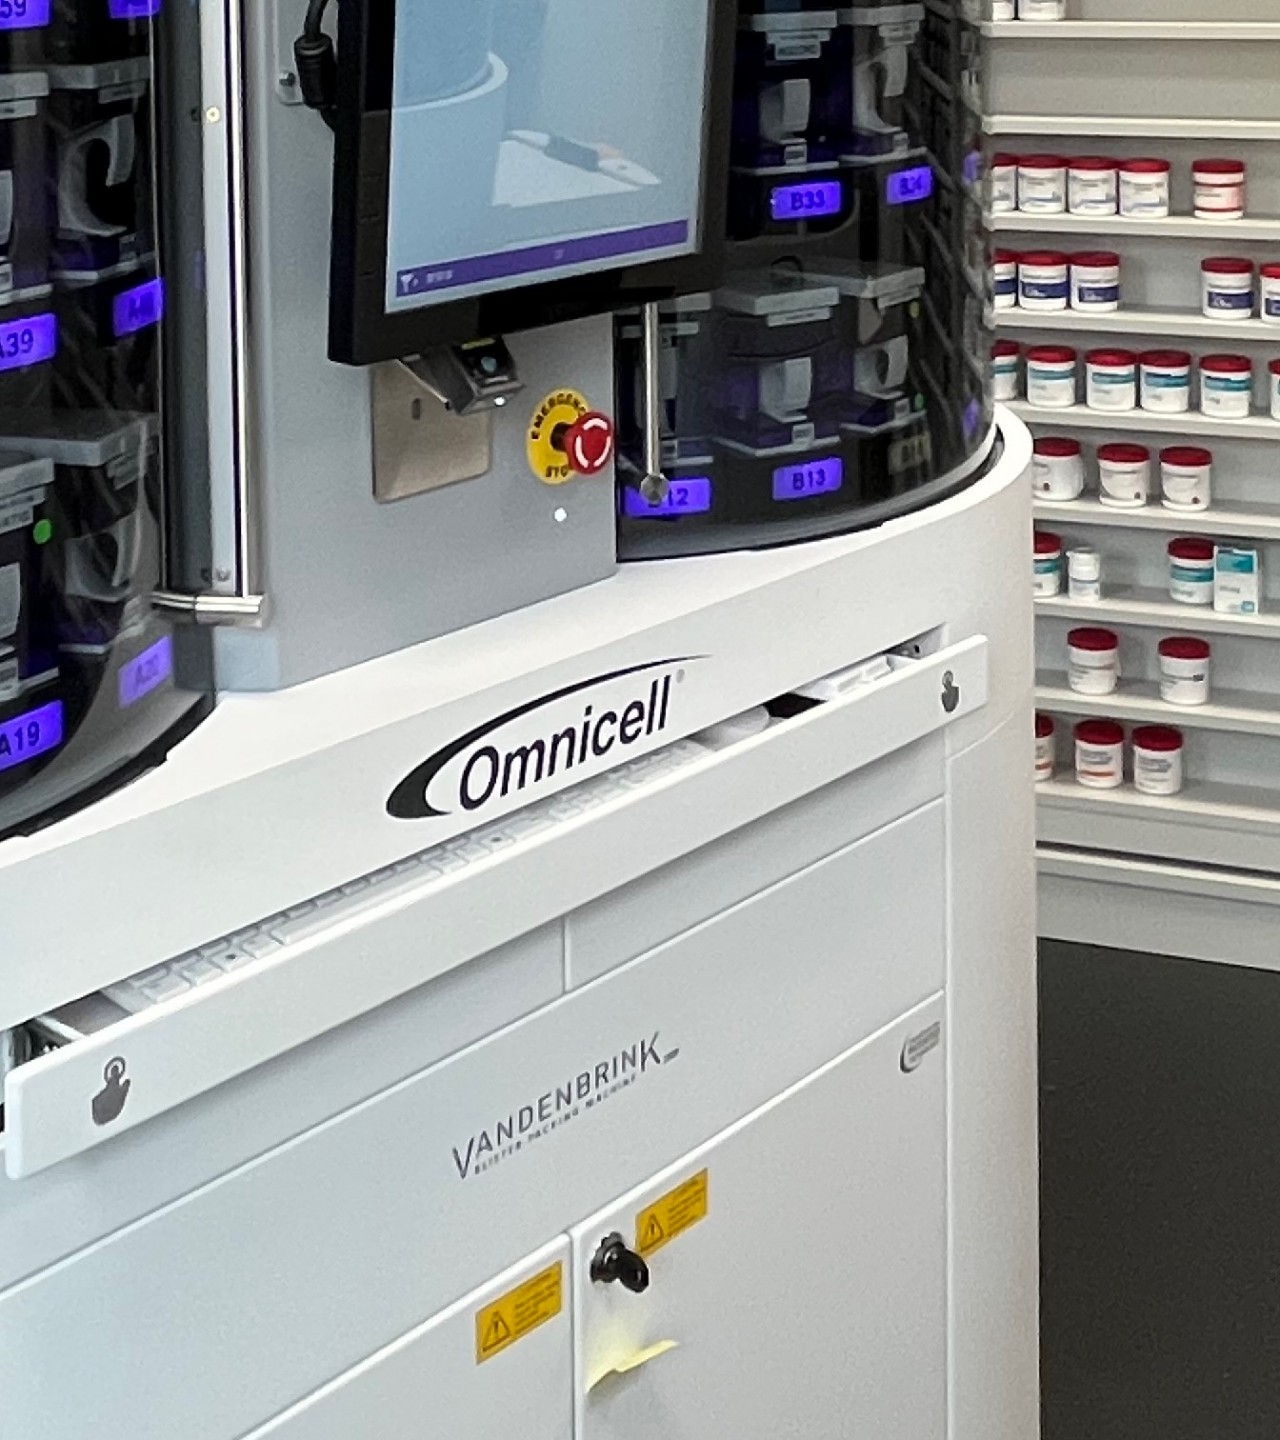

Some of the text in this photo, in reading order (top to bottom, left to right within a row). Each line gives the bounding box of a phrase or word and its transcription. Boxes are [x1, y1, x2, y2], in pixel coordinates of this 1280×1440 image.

[789, 190, 826, 211] B33
[531, 393, 587, 440] EMERGENC
[546, 465, 570, 478] STO
[792, 469, 825, 490] B13
[648, 488, 688, 508] 12
[459, 674, 671, 810] Omnicell
[452, 1031, 660, 1179] VANDENBRINK
